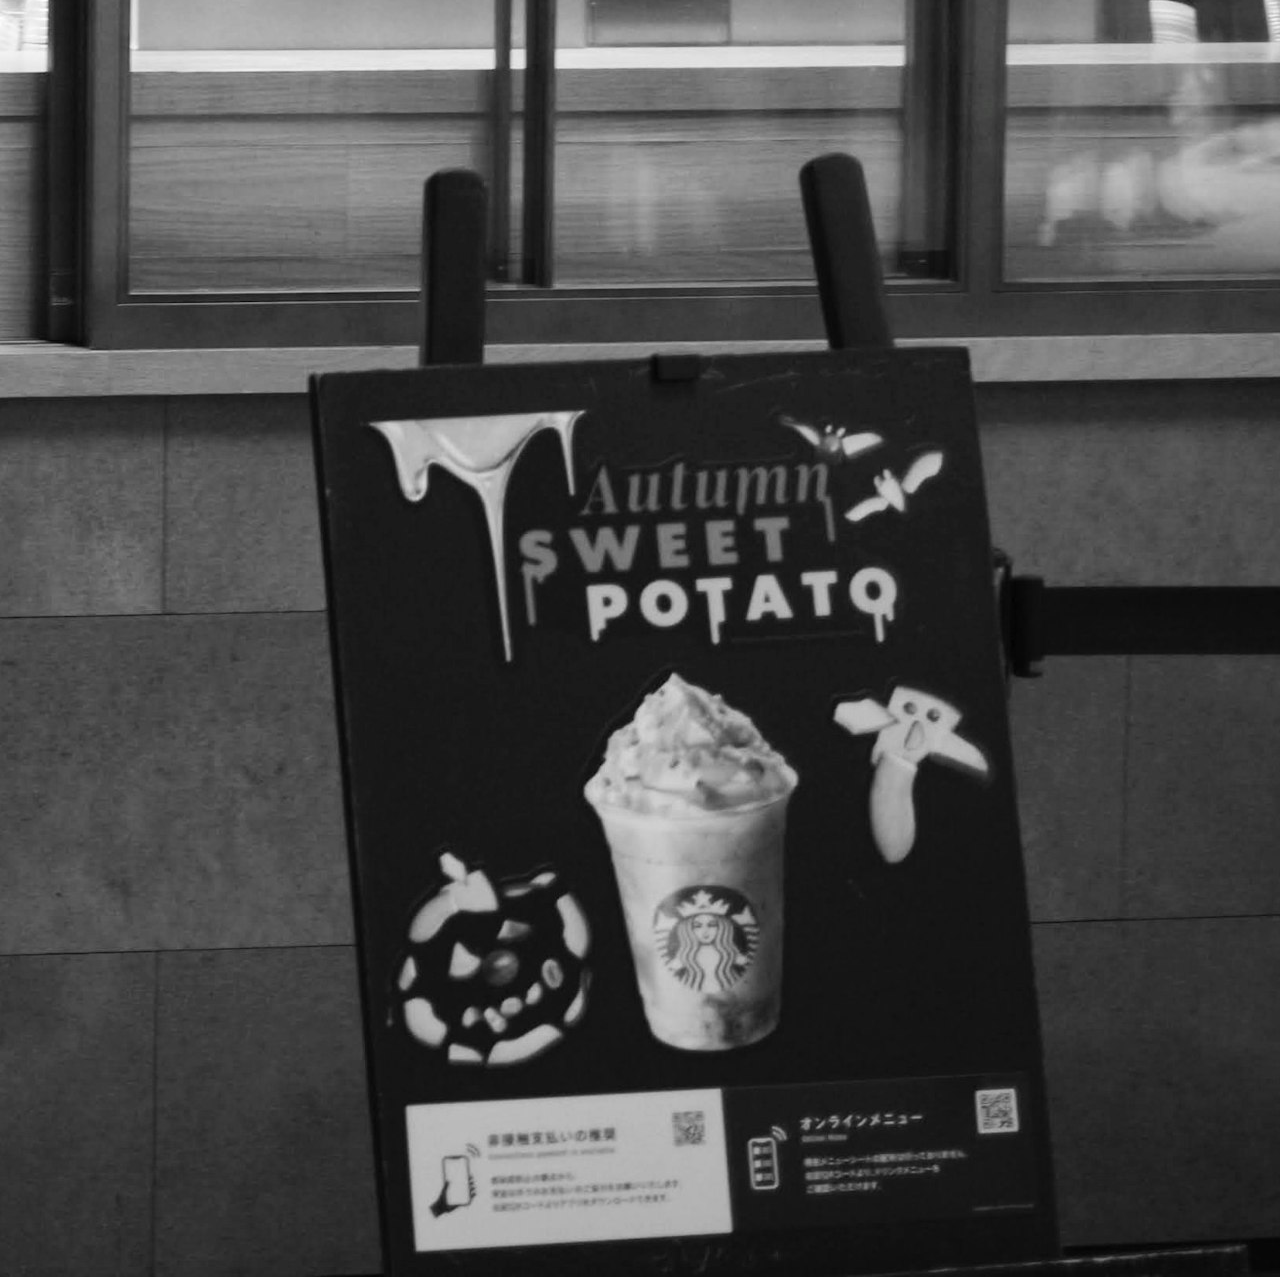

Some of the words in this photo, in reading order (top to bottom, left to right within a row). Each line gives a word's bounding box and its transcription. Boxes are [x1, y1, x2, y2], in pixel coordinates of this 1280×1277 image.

[580, 462, 837, 543] Autumn
[519, 518, 792, 627] SWEET
[585, 566, 899, 645] POTATO
[800, 1113, 923, 1130] オンラインメニュー
